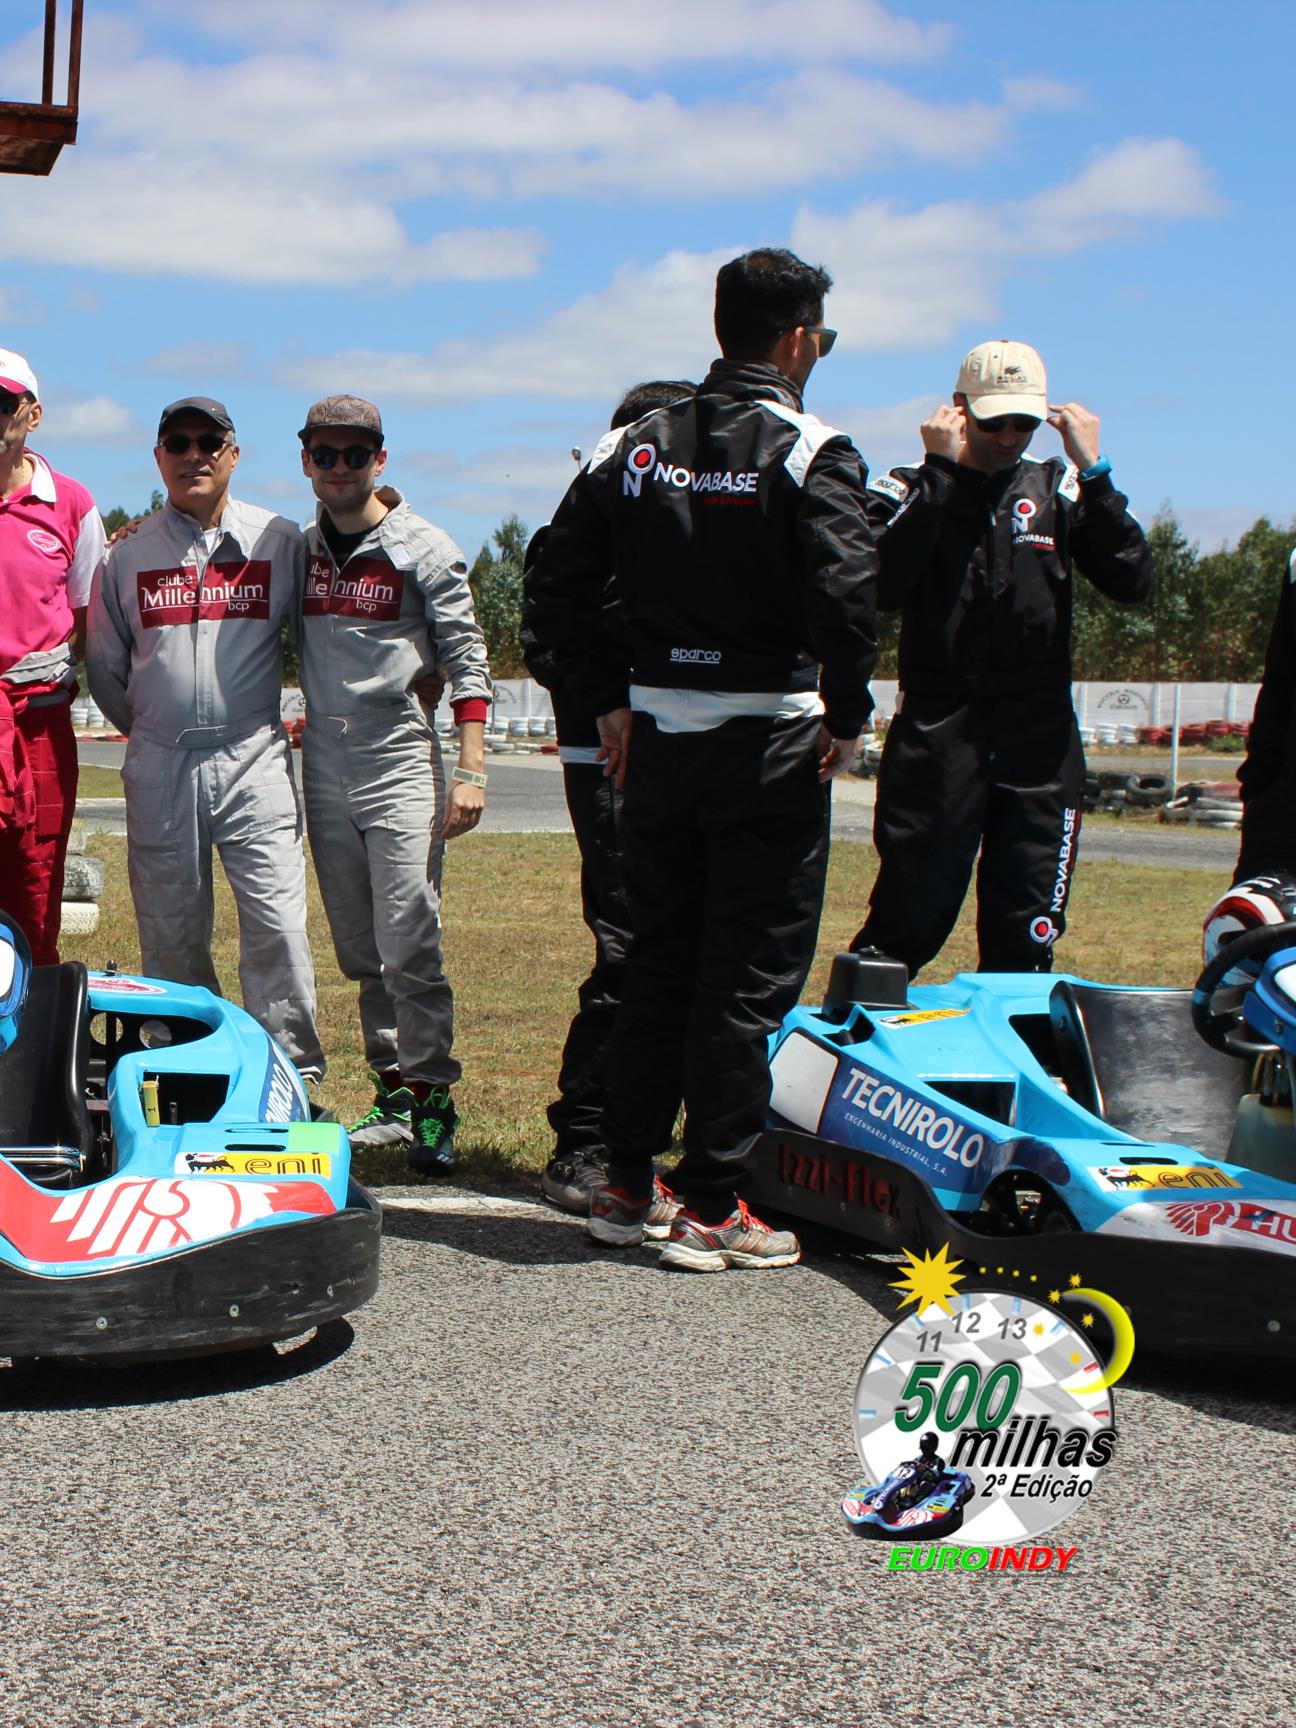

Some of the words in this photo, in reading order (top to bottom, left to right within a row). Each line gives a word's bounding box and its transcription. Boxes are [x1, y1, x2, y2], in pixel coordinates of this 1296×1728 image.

[653, 462, 759, 492] NOVABASE
[1013, 534, 1054, 546] NOVABASE
[157, 573, 193, 587] clube
[306, 576, 393, 601] illennium
[141, 581, 264, 609] Millennium
[228, 601, 250, 612] bcp
[356, 599, 377, 613] bcp
[670, 648, 722, 664] sparco
[1050, 807, 1076, 912] NOVABASE
[841, 1067, 984, 1168] TECNIROLO
[844, 1112, 887, 1142] ENGENHARIA
[888, 1137, 930, 1168] INDUSTRIAL,
[933, 1162, 948, 1176] S.A.
[245, 1152, 320, 1175] eni
[1158, 1167, 1234, 1189] eni
